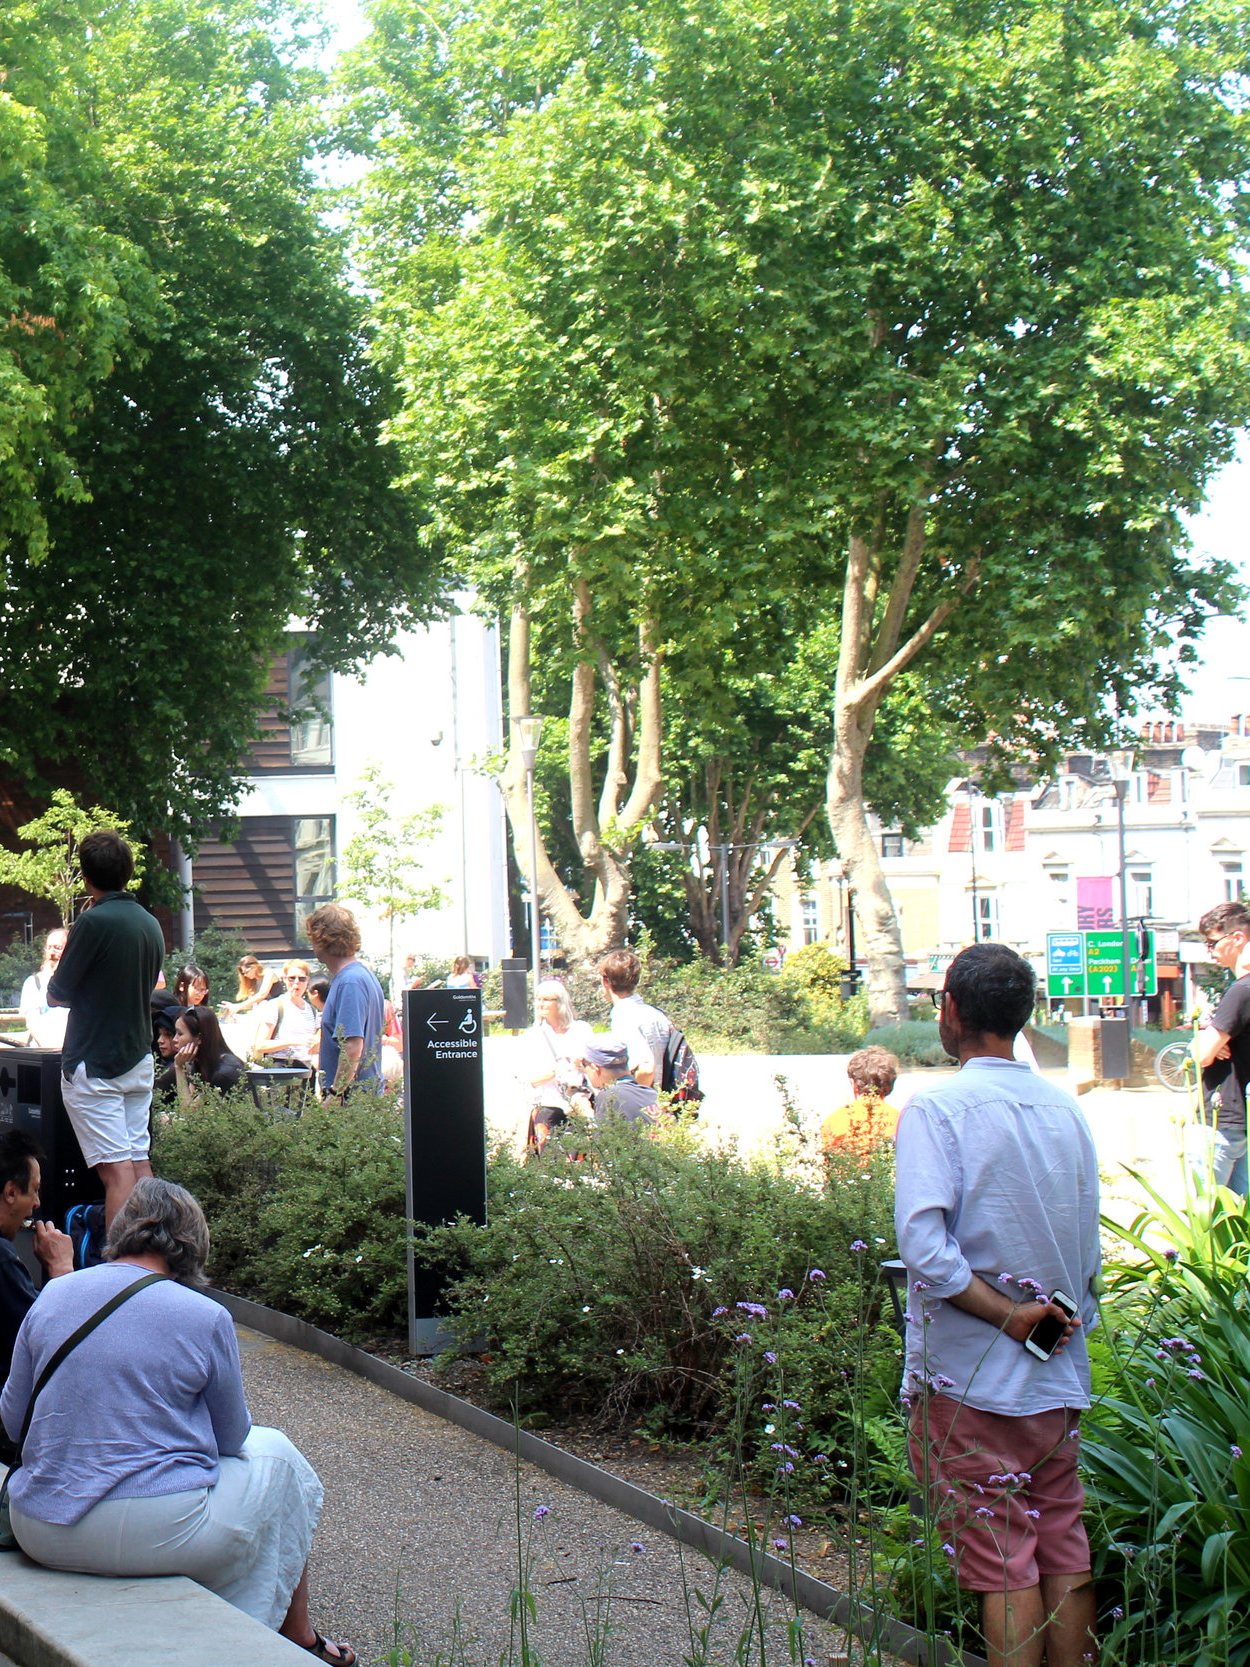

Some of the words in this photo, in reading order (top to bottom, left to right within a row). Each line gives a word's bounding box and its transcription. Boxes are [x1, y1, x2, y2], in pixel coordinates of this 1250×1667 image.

[1088, 965, 1118, 973] (A202)
[427, 1038, 478, 1049] Accessible
[435, 1050, 478, 1059] Entrance
